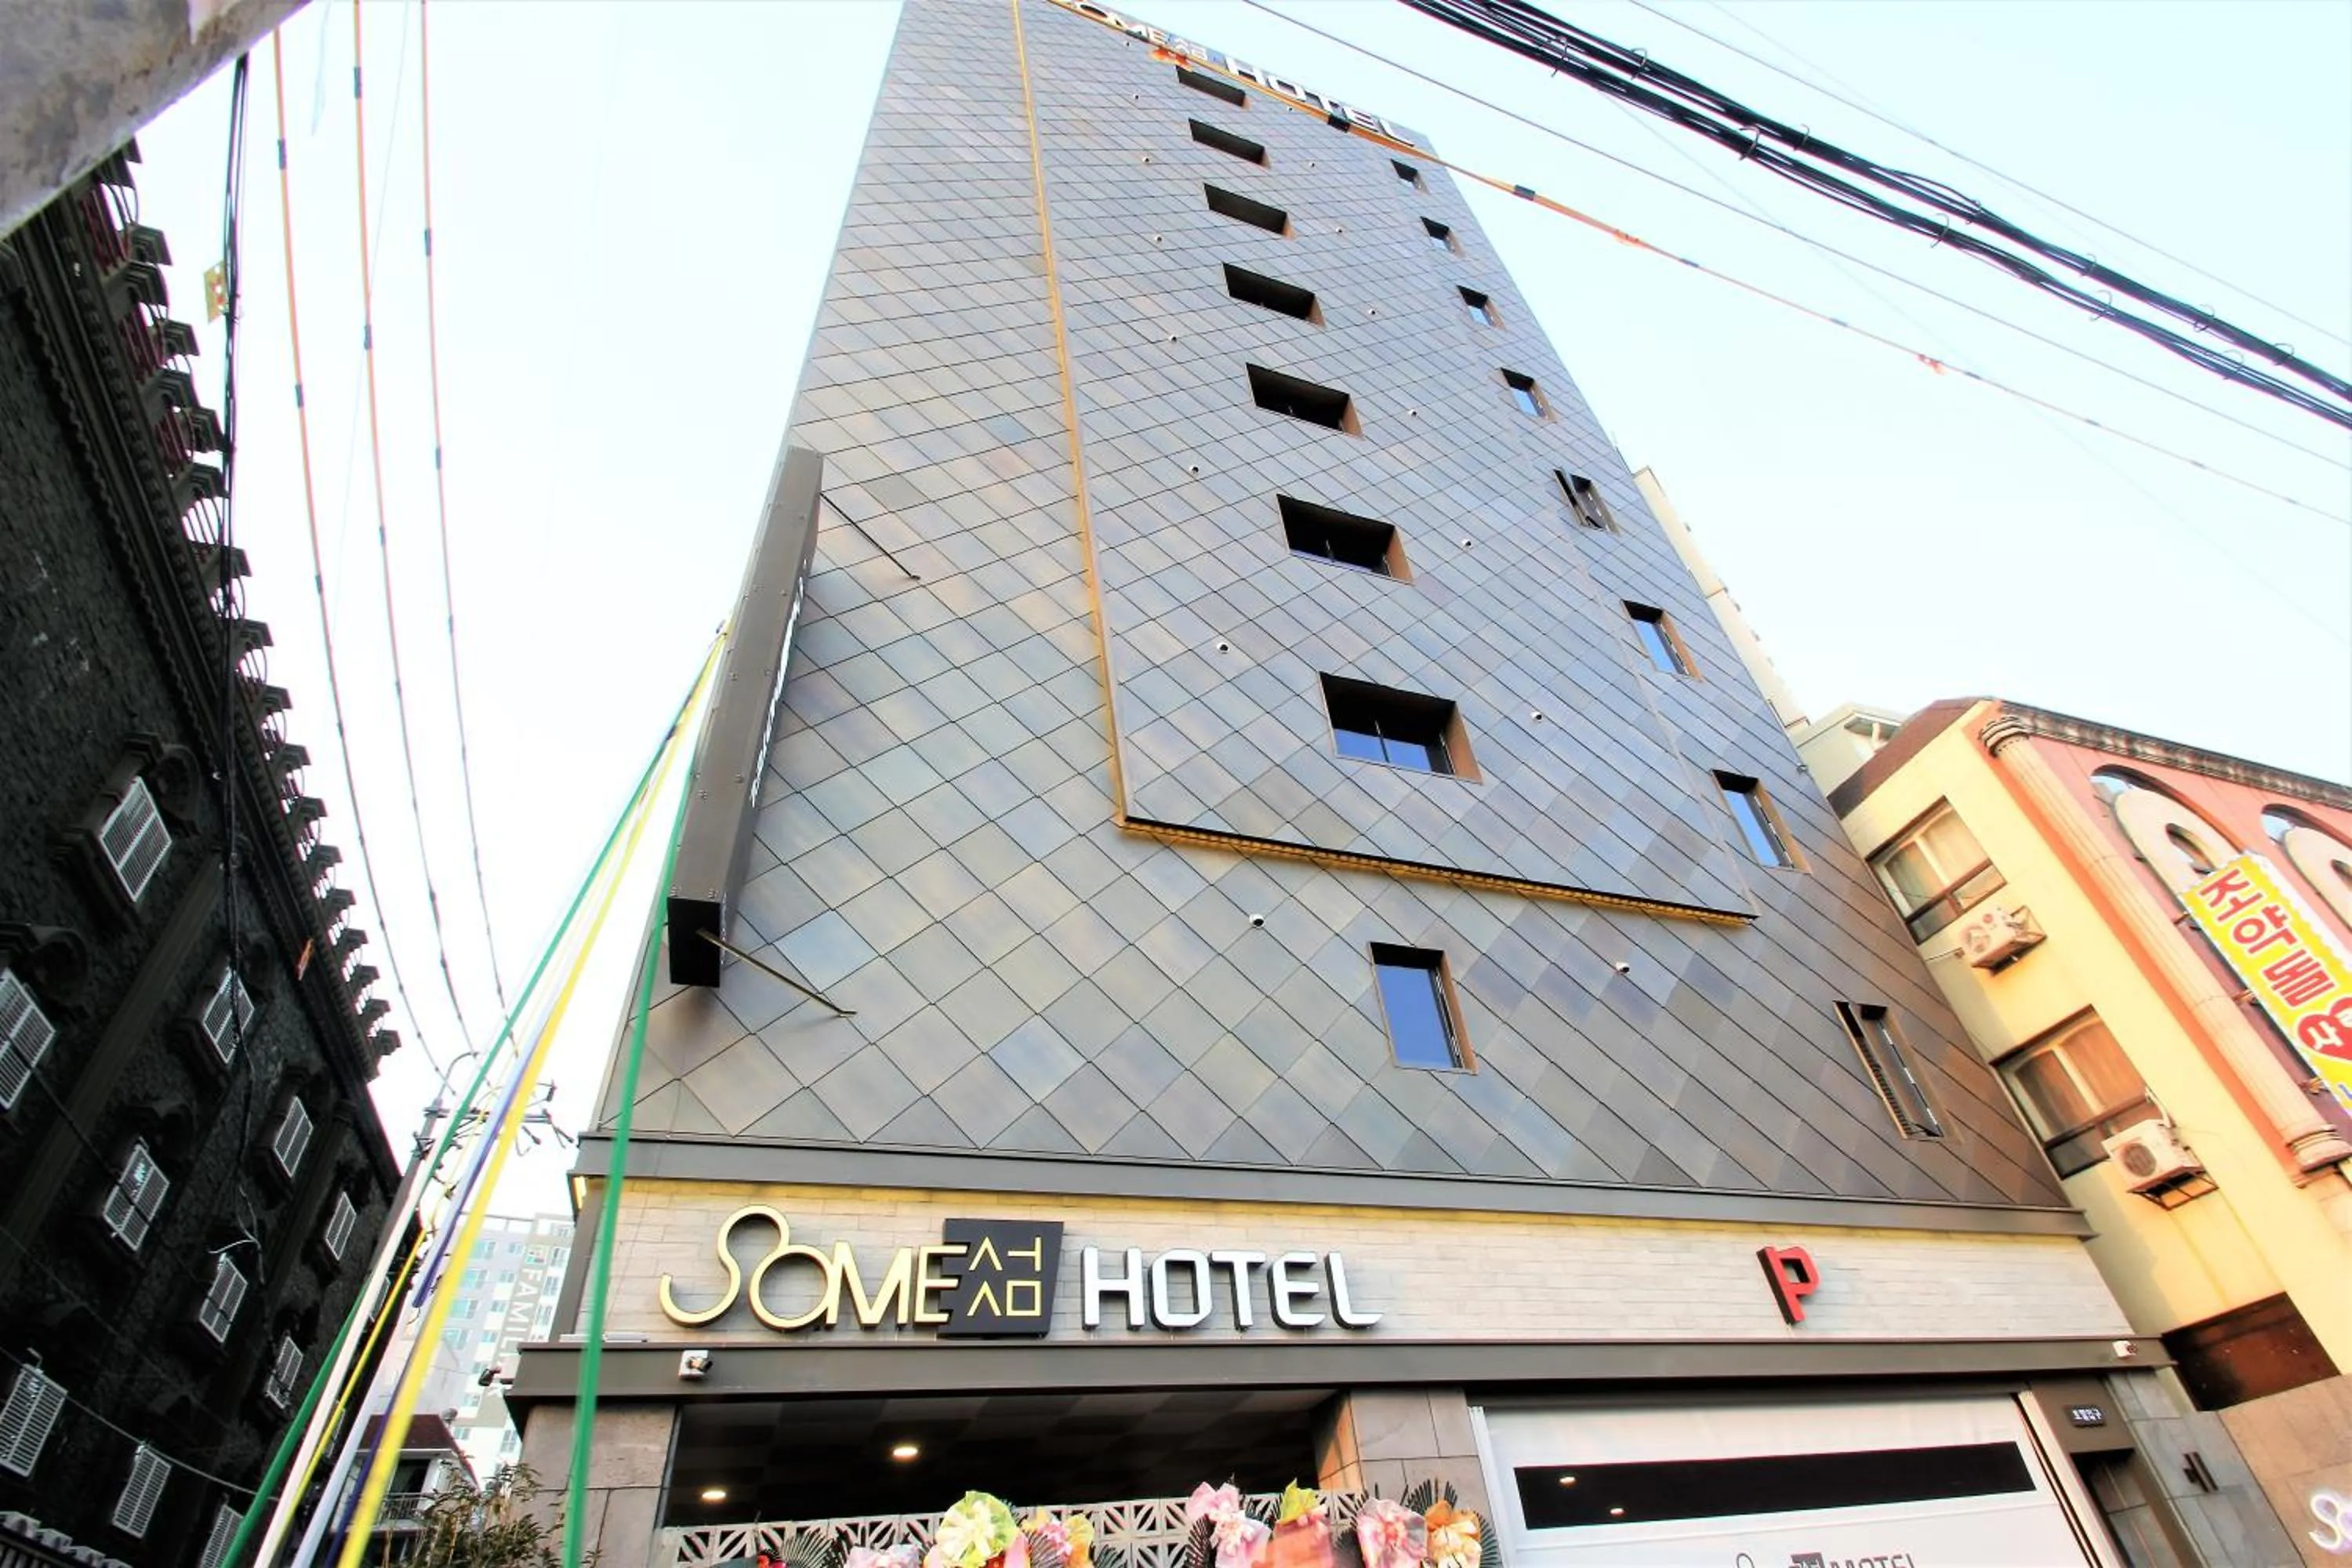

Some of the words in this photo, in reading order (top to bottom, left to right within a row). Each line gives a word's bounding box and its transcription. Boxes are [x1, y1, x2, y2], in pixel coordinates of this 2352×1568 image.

[1225, 55, 1415, 147] HOTEL
[2199, 868, 2336, 1007] 조약돌
[659, 1204, 969, 1333] SOME
[1081, 1247, 1384, 1331] HOTEL
[1756, 1246, 1820, 1327] P
